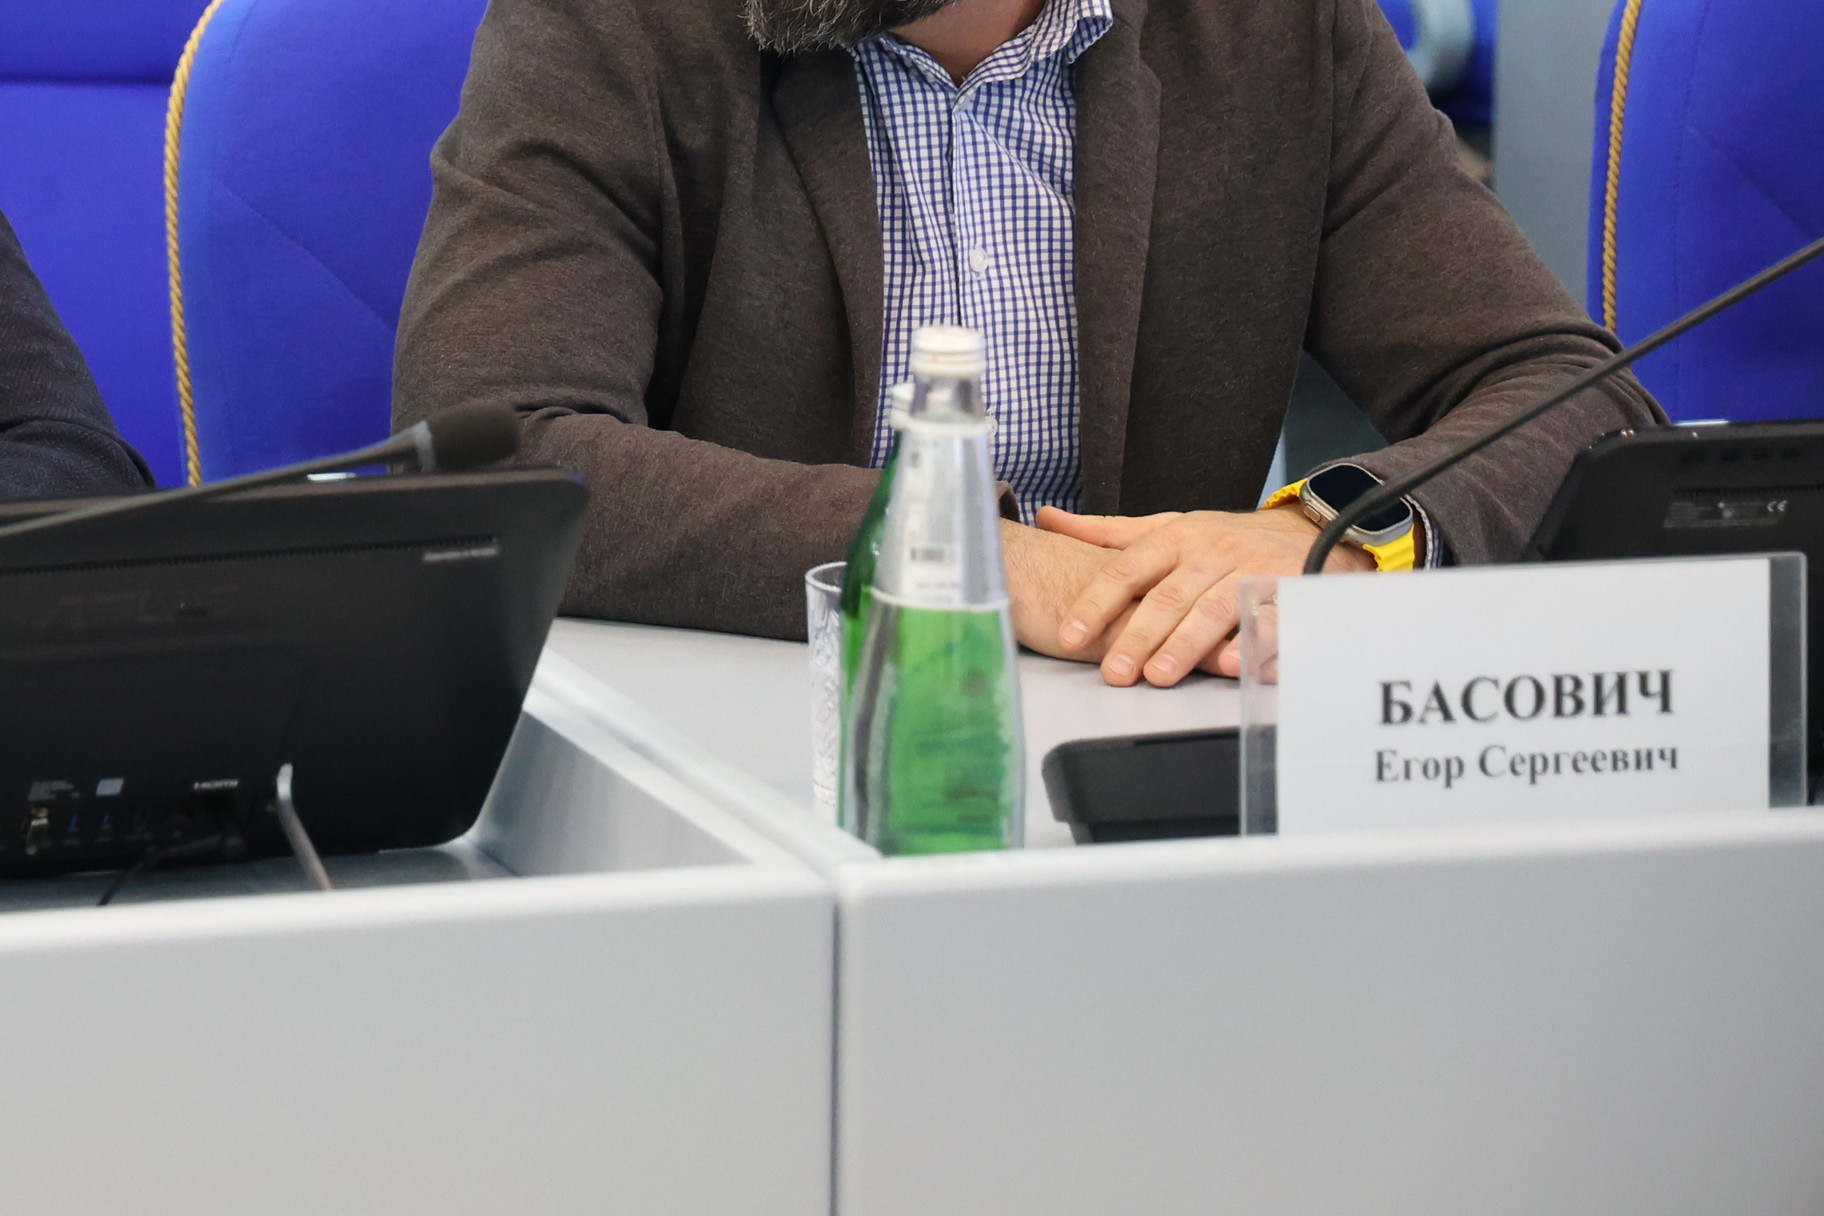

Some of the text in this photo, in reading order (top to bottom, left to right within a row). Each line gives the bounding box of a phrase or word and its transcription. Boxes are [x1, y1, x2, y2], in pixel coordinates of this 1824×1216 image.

[1379, 668, 1674, 727] БАСОВИЧ
[1374, 744, 1679, 790] Егор Сергеевич
